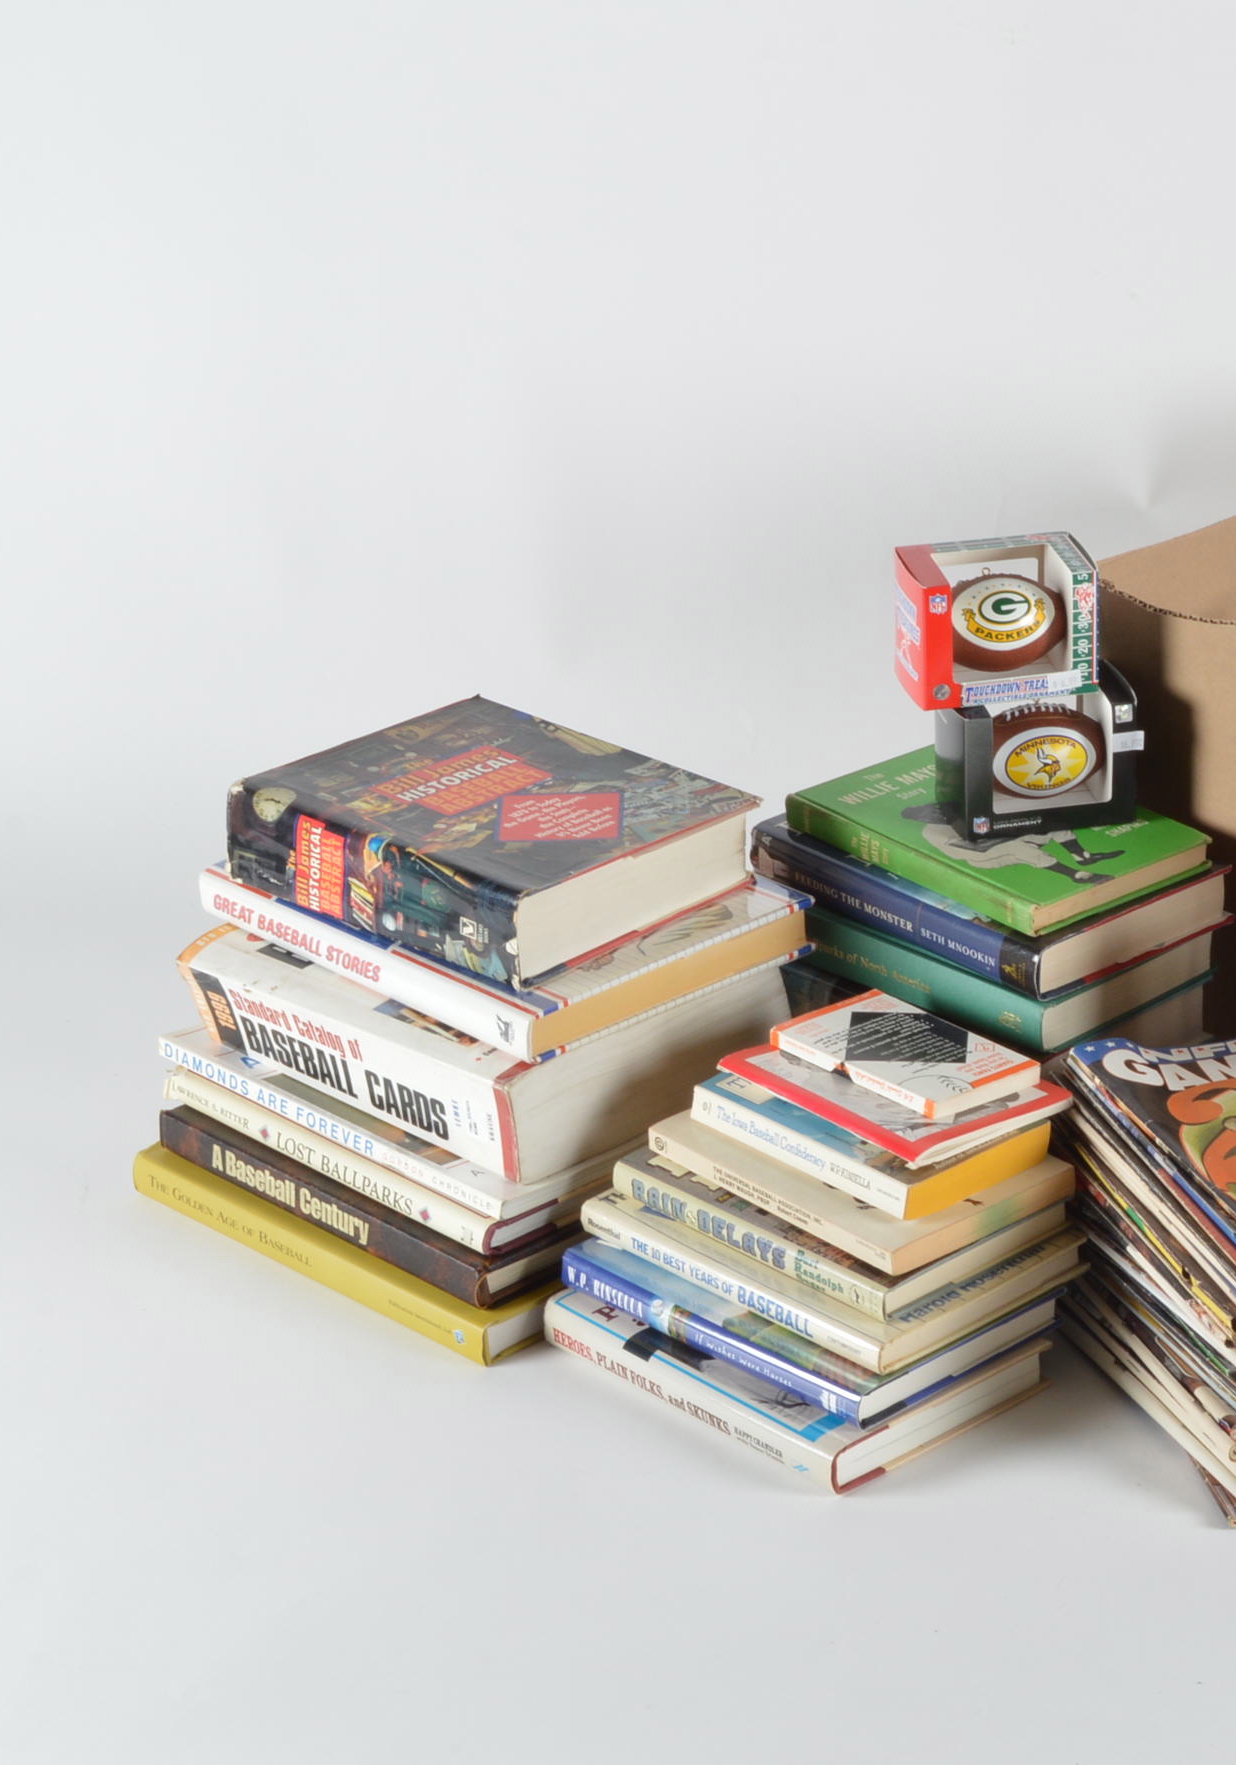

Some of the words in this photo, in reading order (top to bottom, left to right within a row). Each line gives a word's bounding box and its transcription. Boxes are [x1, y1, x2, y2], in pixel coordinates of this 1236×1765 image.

[974, 618, 1041, 641] PACKERS
[966, 682, 1021, 702] TOUCHDOWN
[397, 755, 518, 802] HISTORICAL
[1014, 737, 1076, 757] MINNESOTA
[425, 766, 527, 806] BASEBALL
[440, 771, 544, 812] ABSTRACT
[837, 781, 899, 805] WILLIE
[895, 764, 936, 785] MAYS
[298, 820, 312, 872] James
[308, 826, 323, 911] HISTORICAL
[319, 838, 333, 911] BASEBALL
[330, 838, 343, 915] ABSTRACT
[297, 878, 309, 907] Bill
[795, 872, 838, 900] FEEDING
[842, 892, 862, 909] THE
[863, 902, 913, 933] MONSTER
[920, 928, 945, 945] SETH
[947, 939, 996, 967] MNOOKIN
[213, 894, 256, 923] GREAT
[257, 912, 323, 957] BASEBALL
[325, 945, 381, 984] STORIES
[206, 991, 237, 1031] 1990
[229, 988, 290, 1030] Standard
[292, 1014, 346, 1059] Catalog
[347, 1038, 364, 1062] of
[164, 1042, 249, 1097] DIAMONDS
[257, 1084, 290, 1116] ARE
[296, 1108, 375, 1156] FOREVER
[240, 1015, 359, 1099] BASEBALL
[365, 1068, 450, 1141] CARDS
[220, 1108, 250, 1130] RITTER
[276, 1134, 316, 1166] LOST
[320, 1151, 415, 1216] BALLPARKS
[717, 1105, 731, 1121] The
[731, 1112, 748, 1132] Iowa
[749, 1120, 780, 1146] Baseball
[780, 1135, 826, 1171] Confederacy
[212, 1144, 224, 1173] A
[226, 1150, 296, 1210] Baseball
[299, 1184, 370, 1247] Century
[713, 1165, 723, 1175] THE
[724, 1170, 751, 1191] UNIVERSAL
[752, 1186, 777, 1204] BASEBALL
[632, 1178, 688, 1223] RAIN
[697, 1208, 787, 1270] DELAYS
[631, 1237, 650, 1256] THE
[651, 1247, 661, 1261] 10
[662, 1253, 687, 1274] BEST
[689, 1261, 721, 1288] YEARS
[722, 1277, 735, 1295] OF
[737, 1280, 814, 1338] BASEBALL
[794, 1261, 844, 1293] Randolph
[596, 1352, 629, 1382] PLAIN
[668, 1394, 687, 1412] and
[687, 1402, 731, 1436] SKUNKS
